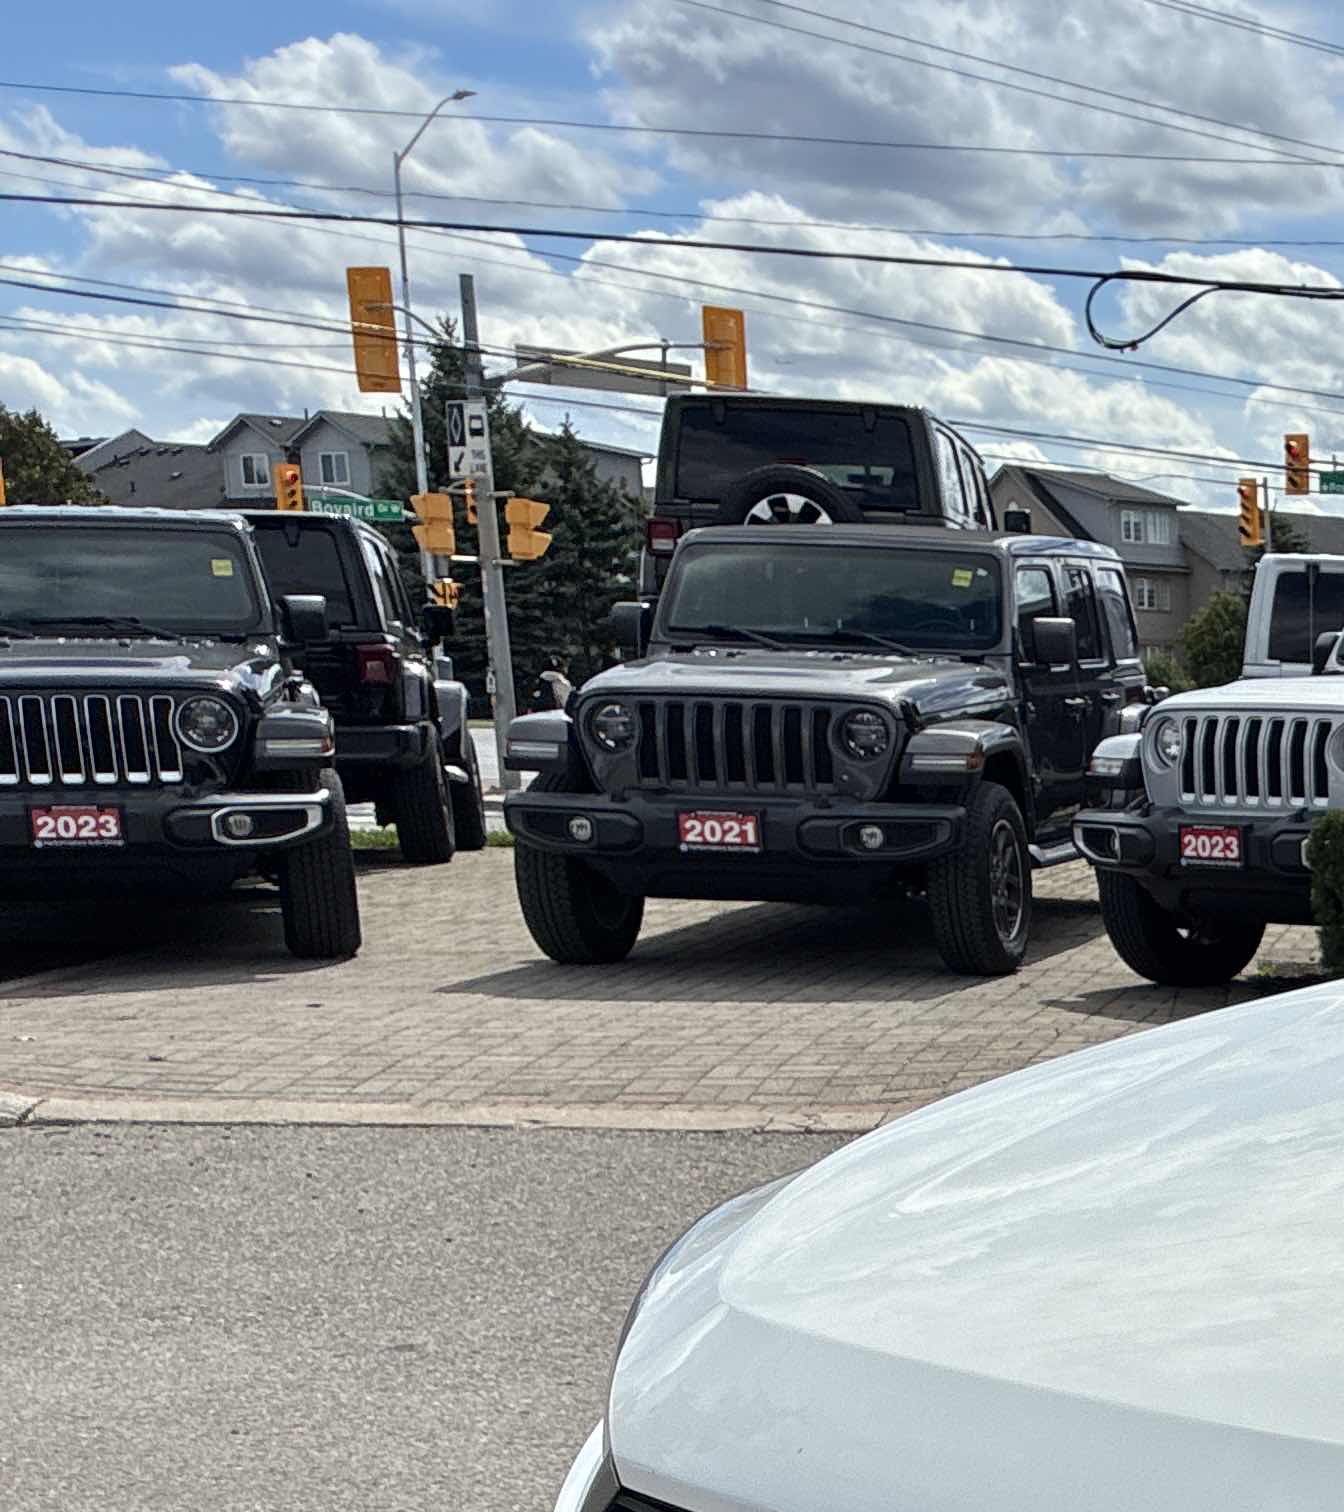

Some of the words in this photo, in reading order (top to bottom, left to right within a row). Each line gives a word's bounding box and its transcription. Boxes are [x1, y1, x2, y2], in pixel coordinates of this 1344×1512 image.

[37, 815, 119, 838] 2023
[684, 819, 756, 844] 2021
[1183, 834, 1240, 859] 2023
